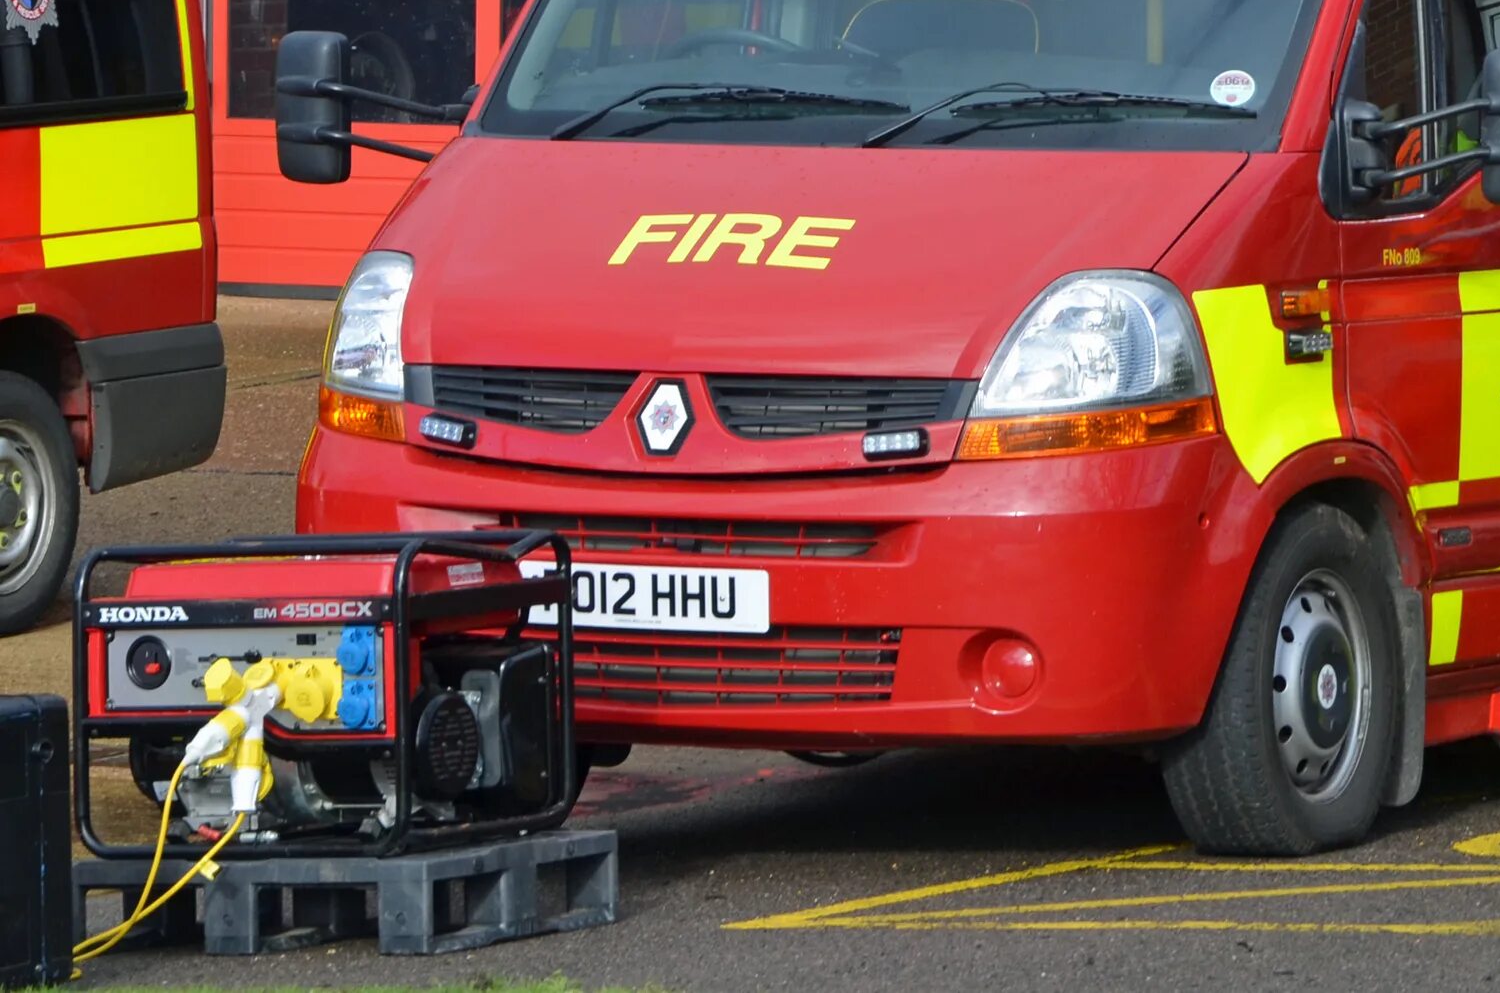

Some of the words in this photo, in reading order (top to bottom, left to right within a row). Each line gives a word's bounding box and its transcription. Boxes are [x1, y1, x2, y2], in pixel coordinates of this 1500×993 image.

[607, 213, 856, 270] FIRE
[253, 607, 277, 620] EM
[280, 601, 373, 619] 4500CX
[544, 568, 637, 616] O12
[651, 574, 736, 619] HHU
[99, 606, 189, 623] HONDA
